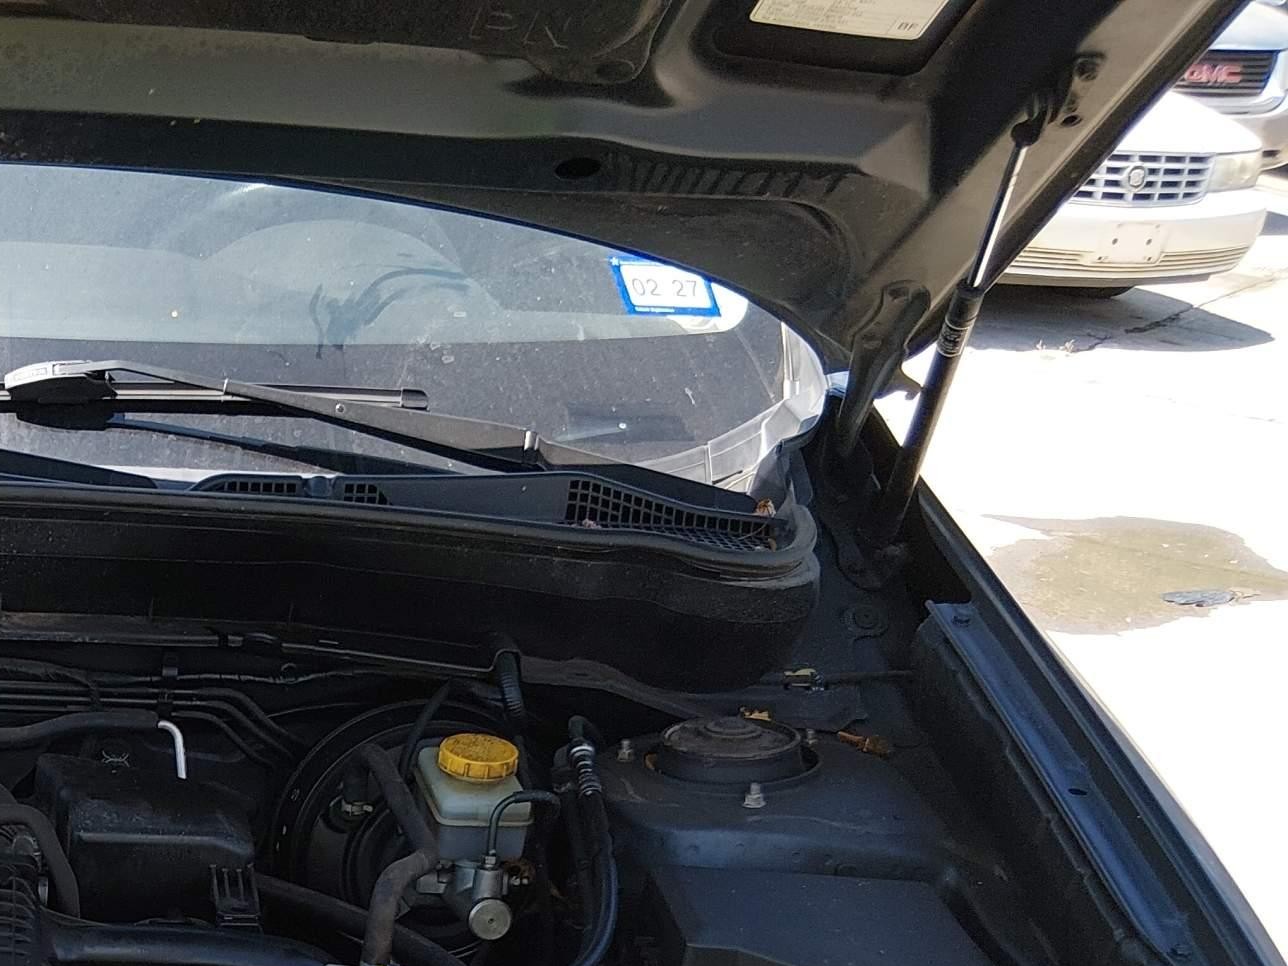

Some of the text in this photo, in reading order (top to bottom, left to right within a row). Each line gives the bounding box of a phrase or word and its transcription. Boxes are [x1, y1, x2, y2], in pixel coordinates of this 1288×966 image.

[1185, 62, 1241, 83] GMC
[632, 278, 697, 297] 02 27
